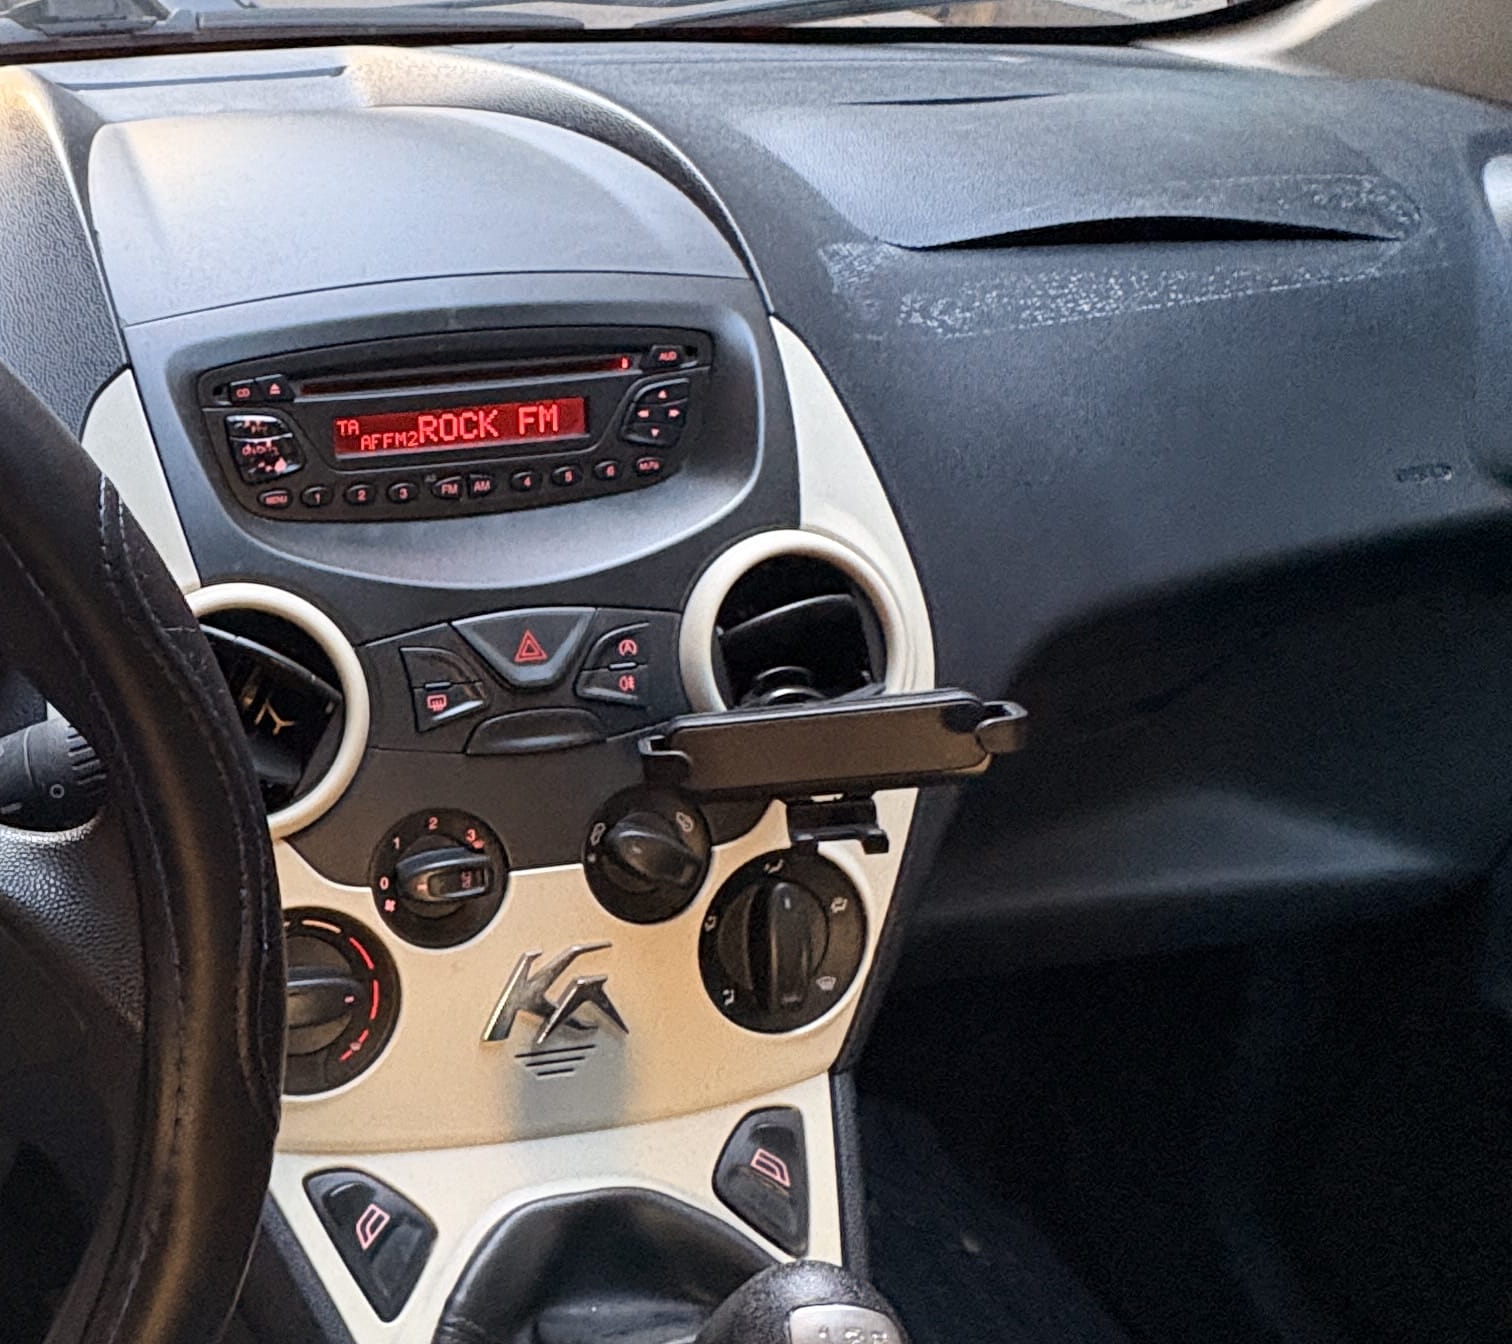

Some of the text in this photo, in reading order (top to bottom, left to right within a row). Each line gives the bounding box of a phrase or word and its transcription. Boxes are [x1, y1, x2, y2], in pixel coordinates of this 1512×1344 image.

[337, 420, 359, 435] TA
[418, 404, 559, 444] ROCK FM
[441, 483, 458, 495] FM
[473, 479, 491, 493] AM
[314, 492, 321, 504] 1
[358, 489, 366, 501] 2
[399, 488, 408, 498] 3
[428, 817, 438, 830] 2
[466, 829, 476, 842] 3
[393, 837, 400, 850] 1
[379, 877, 389, 890] 0
